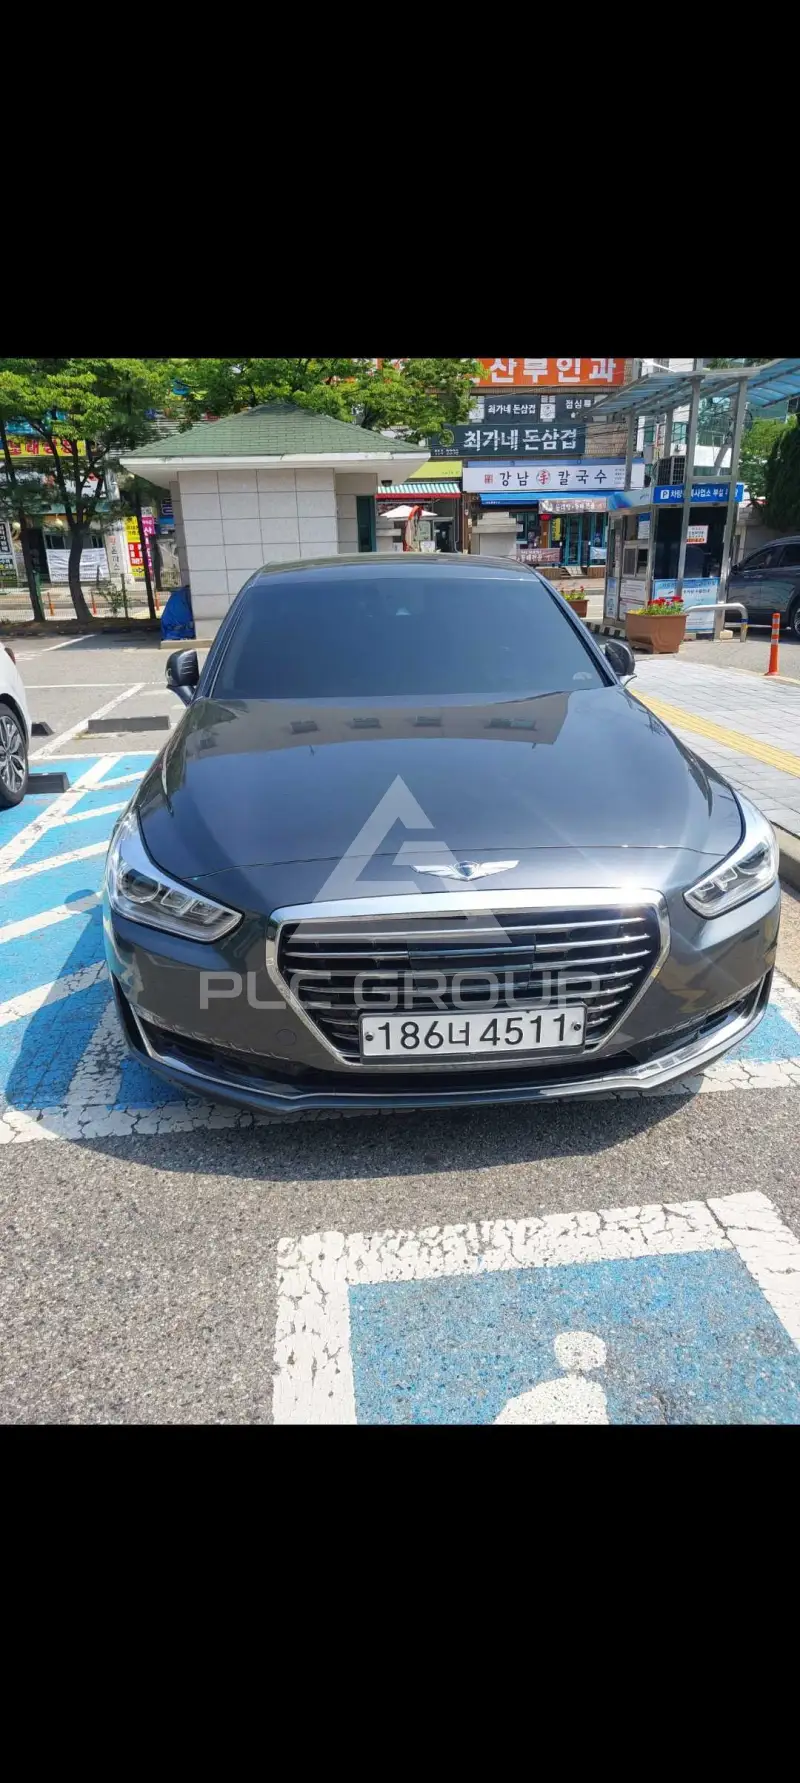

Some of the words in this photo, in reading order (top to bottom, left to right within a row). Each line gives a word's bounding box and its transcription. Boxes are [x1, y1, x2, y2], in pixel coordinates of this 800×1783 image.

[488, 404, 512, 415] 최가네
[512, 404, 536, 415] 돈삼겹
[463, 429, 519, 452] 최가네
[522, 428, 577, 451] 돈삼겹
[499, 471, 530, 487] 강남
[558, 469, 608, 486] 칼국수
[670, 488, 711, 499] 차량사업소
[378, 1020, 470, 1050] 186너
[479, 1013, 565, 1046] 4511
